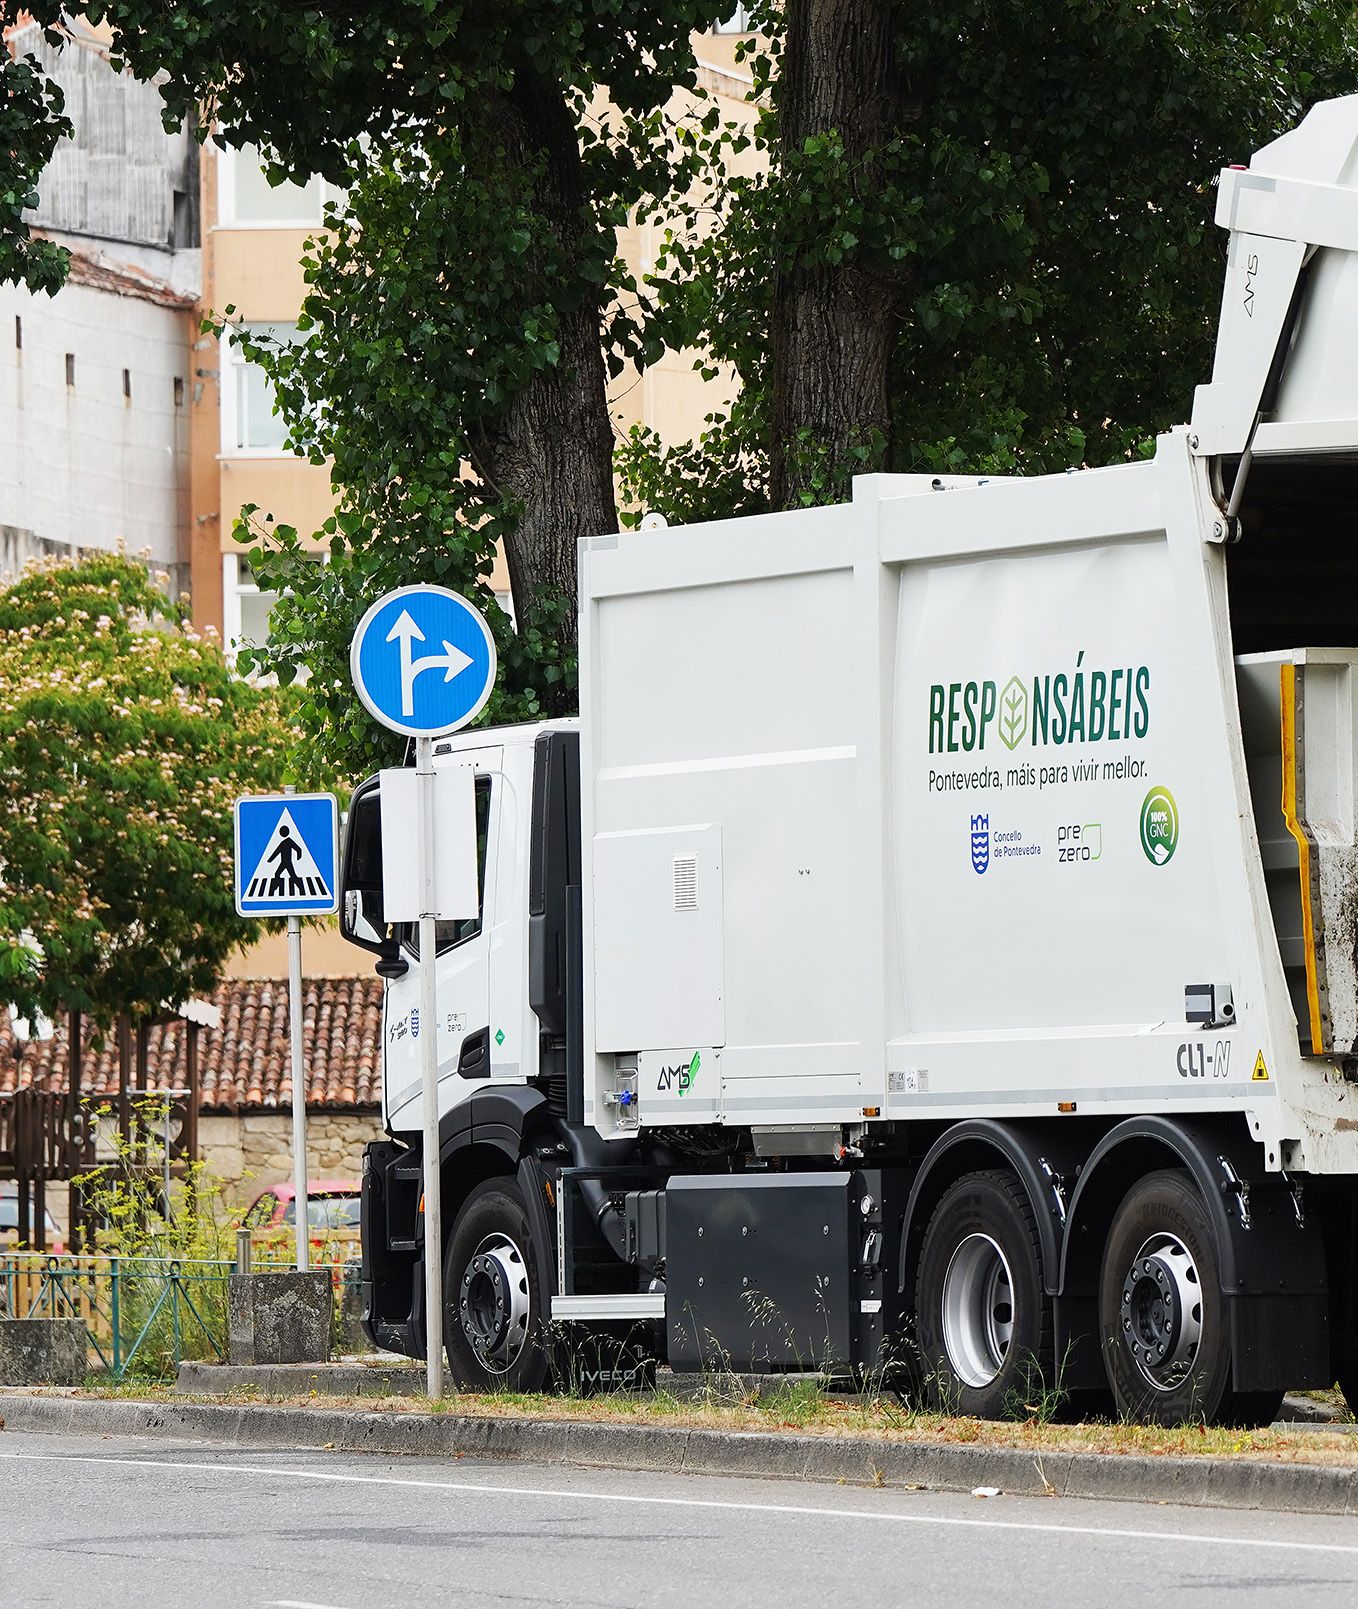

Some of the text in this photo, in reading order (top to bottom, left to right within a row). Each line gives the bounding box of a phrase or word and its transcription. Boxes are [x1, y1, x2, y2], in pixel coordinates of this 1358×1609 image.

[928, 755, 1148, 792] Pontevedra, máis para vivir mellor.
[1150, 811, 1168, 823] 100%
[993, 830, 1022, 843] Concello
[1057, 825, 1081, 845] pre
[1149, 823, 1169, 838] GNC
[993, 844, 1042, 858] de Pontevedra
[1058, 846, 1091, 862] zero
[657, 1064, 691, 1091] AMS
[580, 1369, 637, 1382] IVECO
